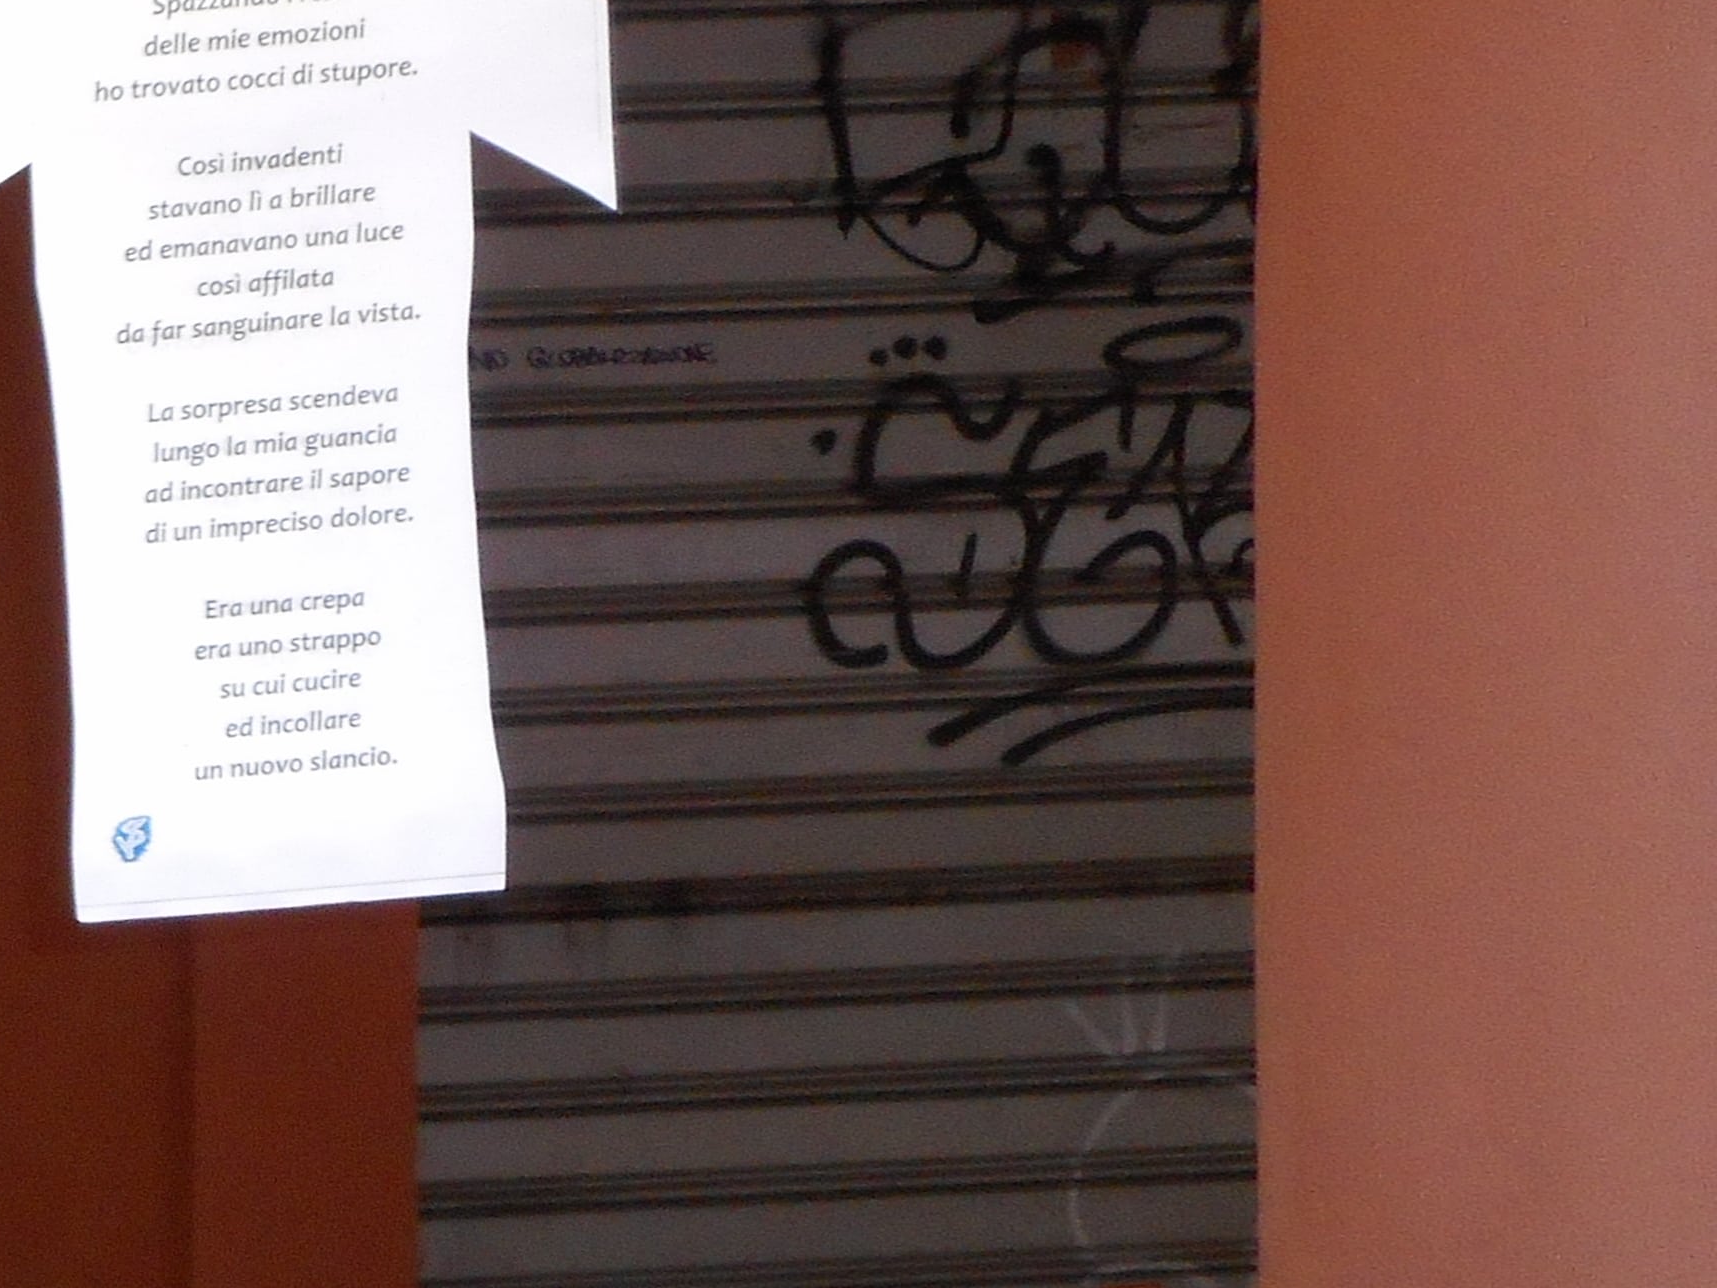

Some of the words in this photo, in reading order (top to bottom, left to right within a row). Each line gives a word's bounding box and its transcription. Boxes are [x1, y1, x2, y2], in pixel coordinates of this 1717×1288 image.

[143, 31, 201, 57] delle
[207, 27, 251, 52] mie
[256, 17, 366, 48] emozioni
[94, 80, 125, 103] ho
[130, 74, 221, 100] trovato
[226, 65, 286, 91] cocci
[291, 62, 314, 86] di
[319, 60, 419, 87] stupore.
[176, 152, 225, 177] Così
[231, 142, 344, 173] invadenti
[148, 197, 243, 221] stavano
[248, 189, 262, 212] lì
[268, 193, 283, 211] a
[289, 183, 376, 209] brillare
[123, 239, 153, 263] ed
[158, 233, 299, 260] emanavano
[305, 228, 350, 248] una
[356, 221, 405, 244] luce
[196, 272, 242, 297] così
[247, 267, 335, 297] affilata
[115, 322, 146, 345] da
[151, 319, 187, 348] far
[190, 311, 324, 342] sanguinare
[329, 304, 351, 327] la
[356, 302, 422, 325] vista.
[147, 403, 174, 424] La
[180, 396, 283, 424] sorpresa
[288, 384, 399, 412] scendeva
[153, 441, 221, 467] lungo
[225, 435, 248, 457] la
[253, 431, 298, 455] mia
[303, 423, 398, 458] guancia
[144, 480, 174, 504] ad
[179, 475, 304, 501] incontrare
[308, 467, 323, 491] il
[329, 466, 411, 493] sapore
[144, 521, 168, 544] di
[173, 524, 203, 542] un
[209, 511, 324, 543] impreciso
[329, 504, 414, 529] dolore.
[204, 599, 244, 620] Era
[249, 597, 294, 616] una
[299, 591, 365, 615] crepa
[194, 642, 232, 661] era
[238, 638, 284, 657] uno
[288, 630, 382, 655] strappo
[219, 682, 246, 700] su
[252, 672, 286, 696] cui
[292, 668, 362, 693] cucire
[224, 715, 254, 739] ed
[260, 709, 362, 736] incollare
[194, 764, 223, 781] un
[229, 757, 304, 778] nuovo
[309, 745, 398, 772] slancio.
